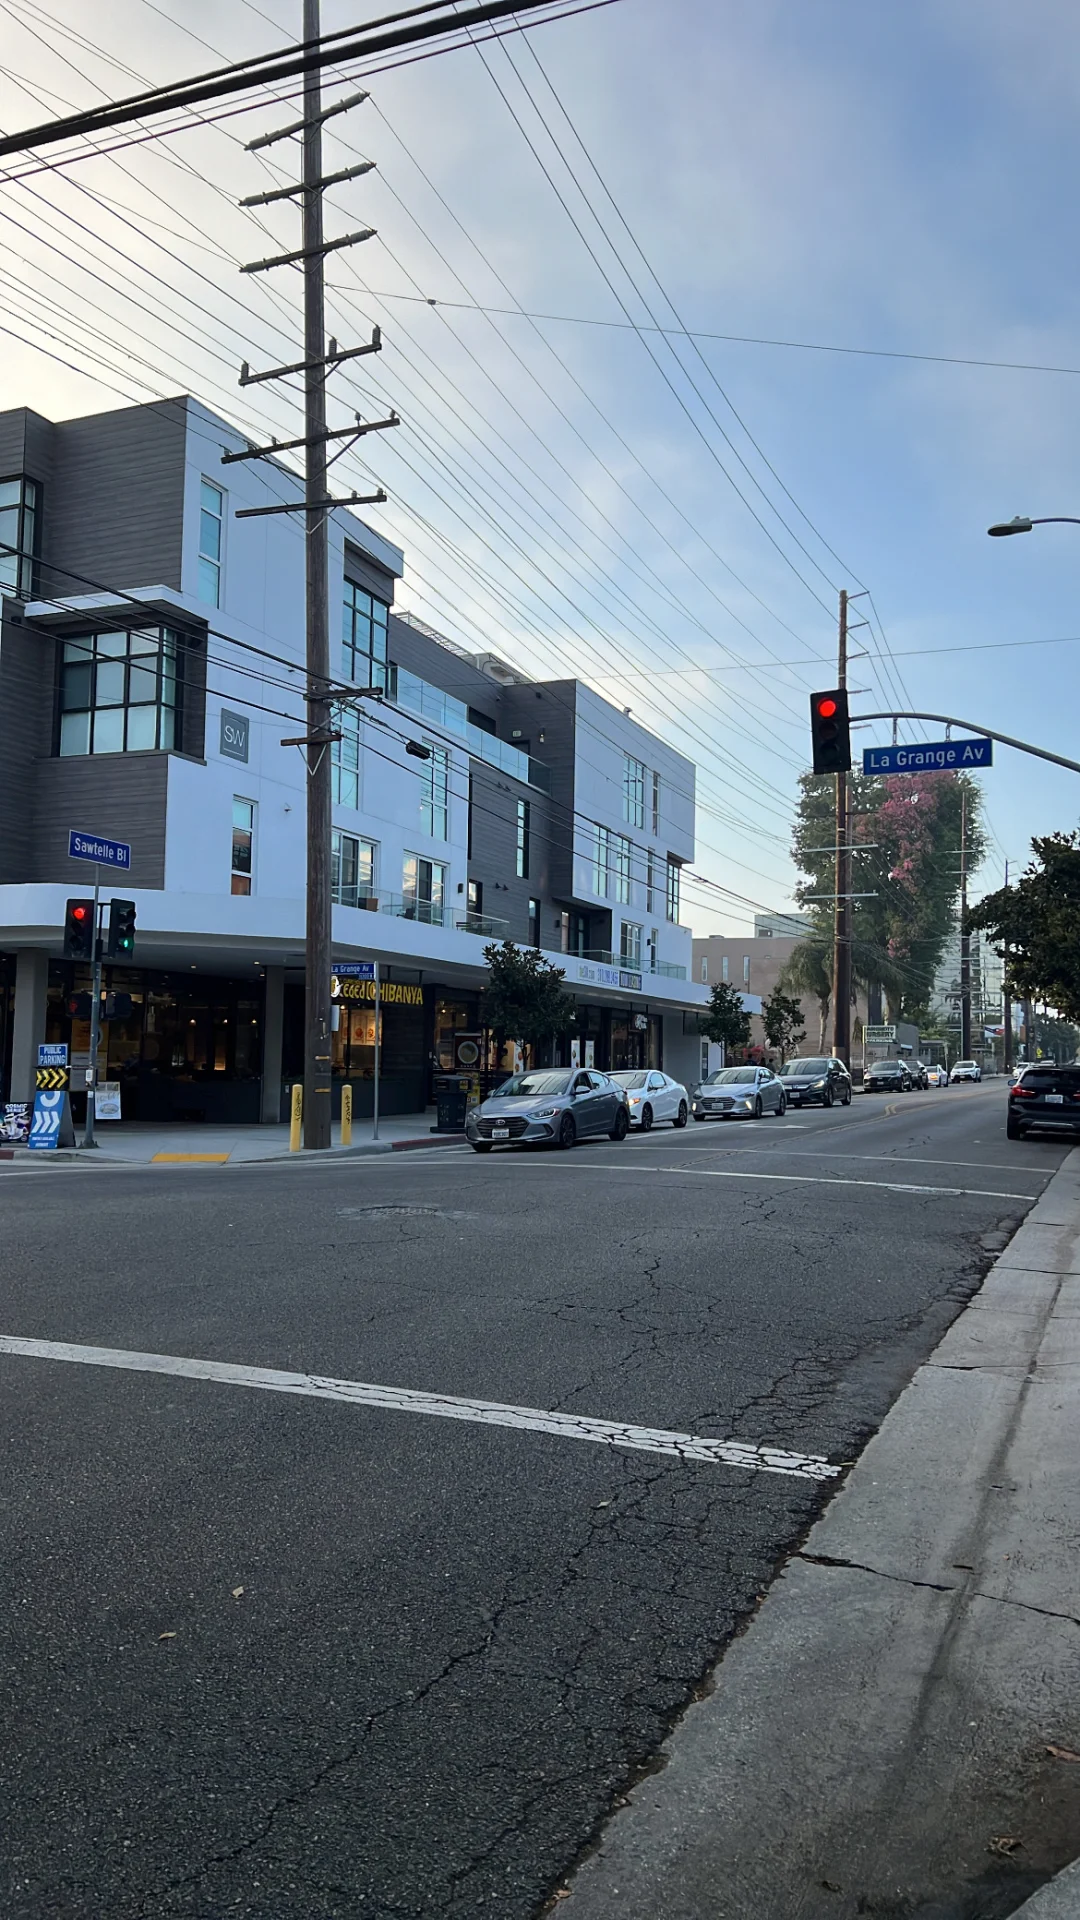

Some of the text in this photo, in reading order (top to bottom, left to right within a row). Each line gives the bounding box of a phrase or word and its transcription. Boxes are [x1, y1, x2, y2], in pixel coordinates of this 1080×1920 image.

[870, 745, 984, 768] La Grange Av
[74, 837, 127, 862] Sawtelle Bl
[340, 965, 360, 974] Grange
[43, 1046, 62, 1054] PUBLIC
[40, 1055, 66, 1064] PARKING
